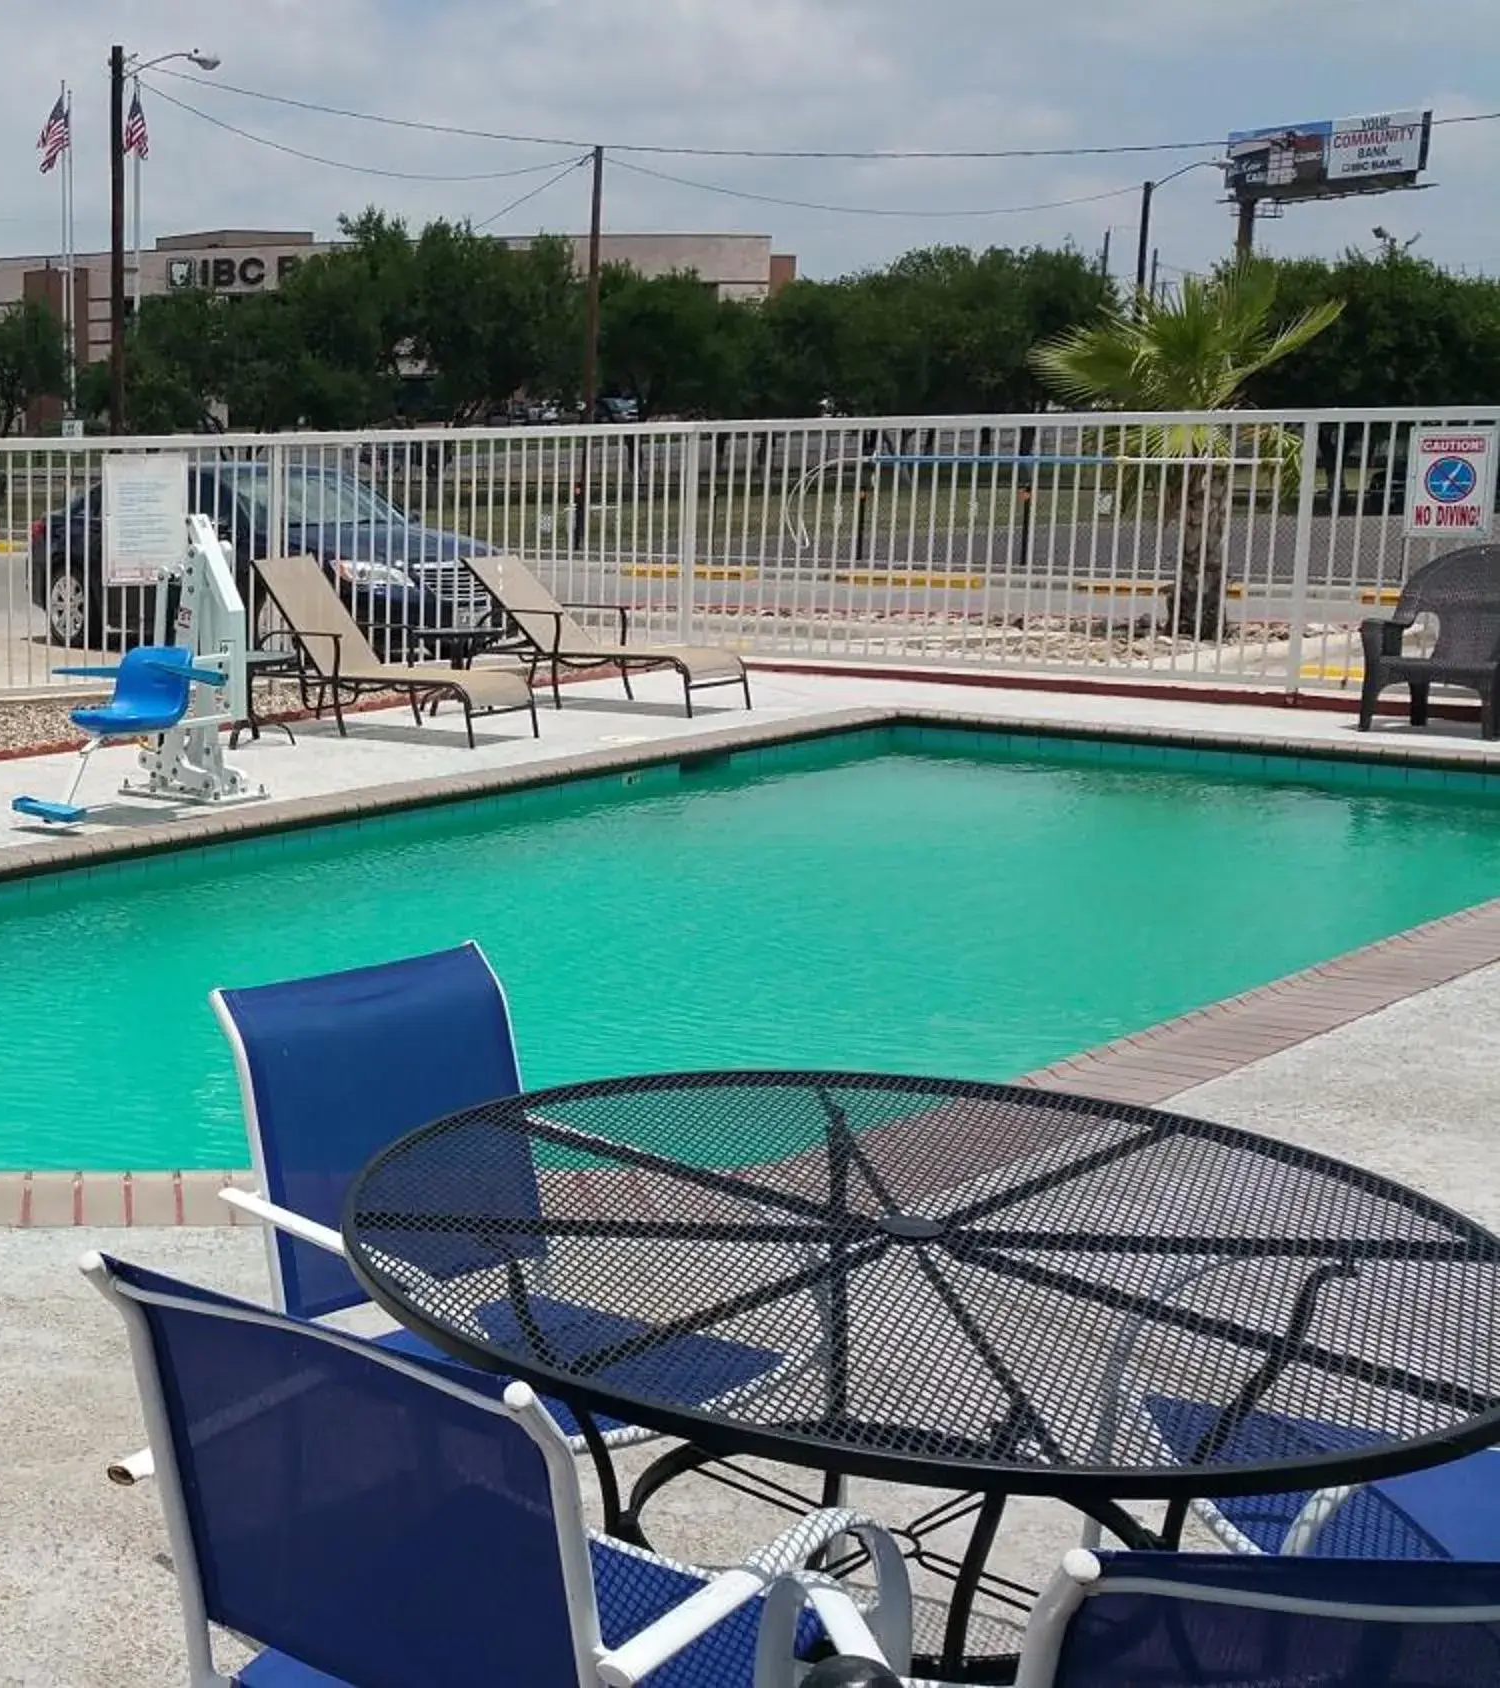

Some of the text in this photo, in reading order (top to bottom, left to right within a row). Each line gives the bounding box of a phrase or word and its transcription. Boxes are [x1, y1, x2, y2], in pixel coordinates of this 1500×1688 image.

[1361, 116, 1390, 130] YOUR
[1334, 127, 1415, 149] COMMUNITY
[1357, 144, 1389, 159] BANK
[201, 257, 265, 286] IBC
[1414, 505, 1481, 526] NO DIVING!
